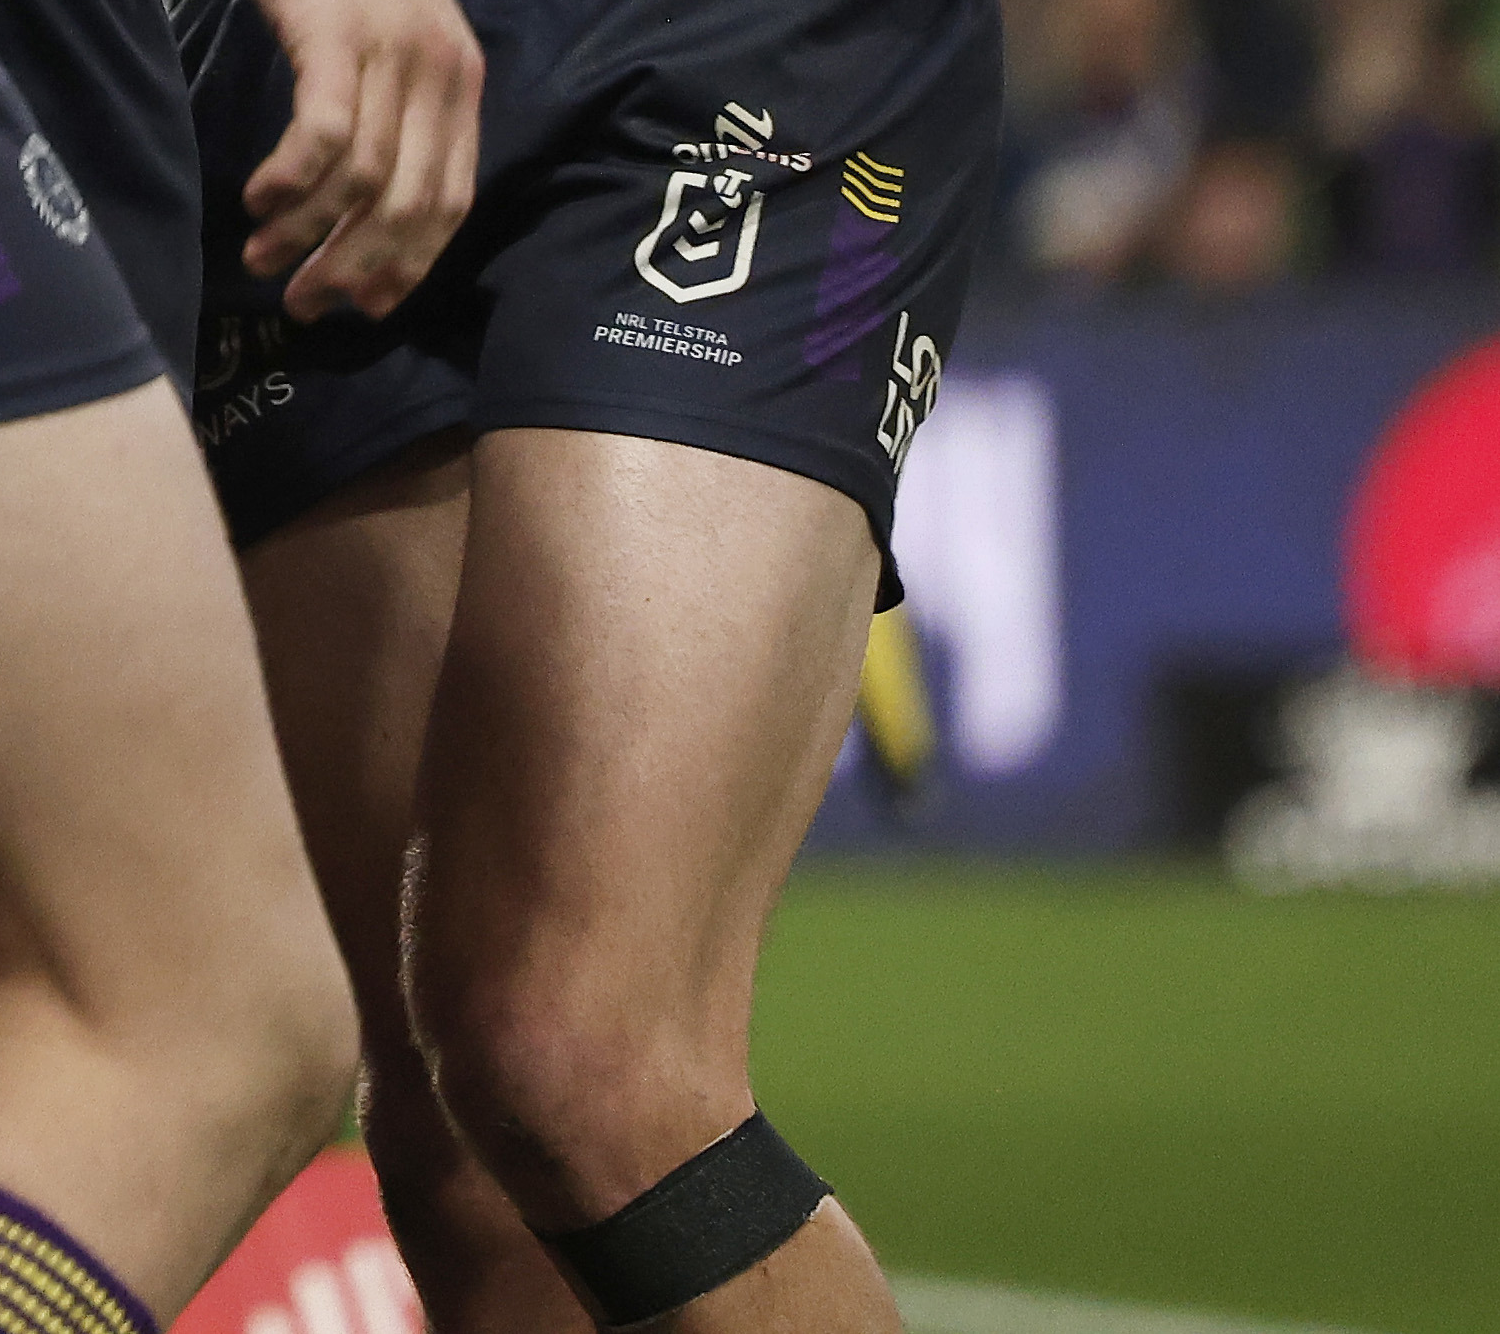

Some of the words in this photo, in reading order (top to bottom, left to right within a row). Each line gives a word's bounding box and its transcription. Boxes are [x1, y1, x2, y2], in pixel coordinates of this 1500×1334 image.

[593, 326, 744, 367] PREMIERSHIP
[614, 311, 648, 330] NRL
[652, 317, 729, 347] TELSTRA
